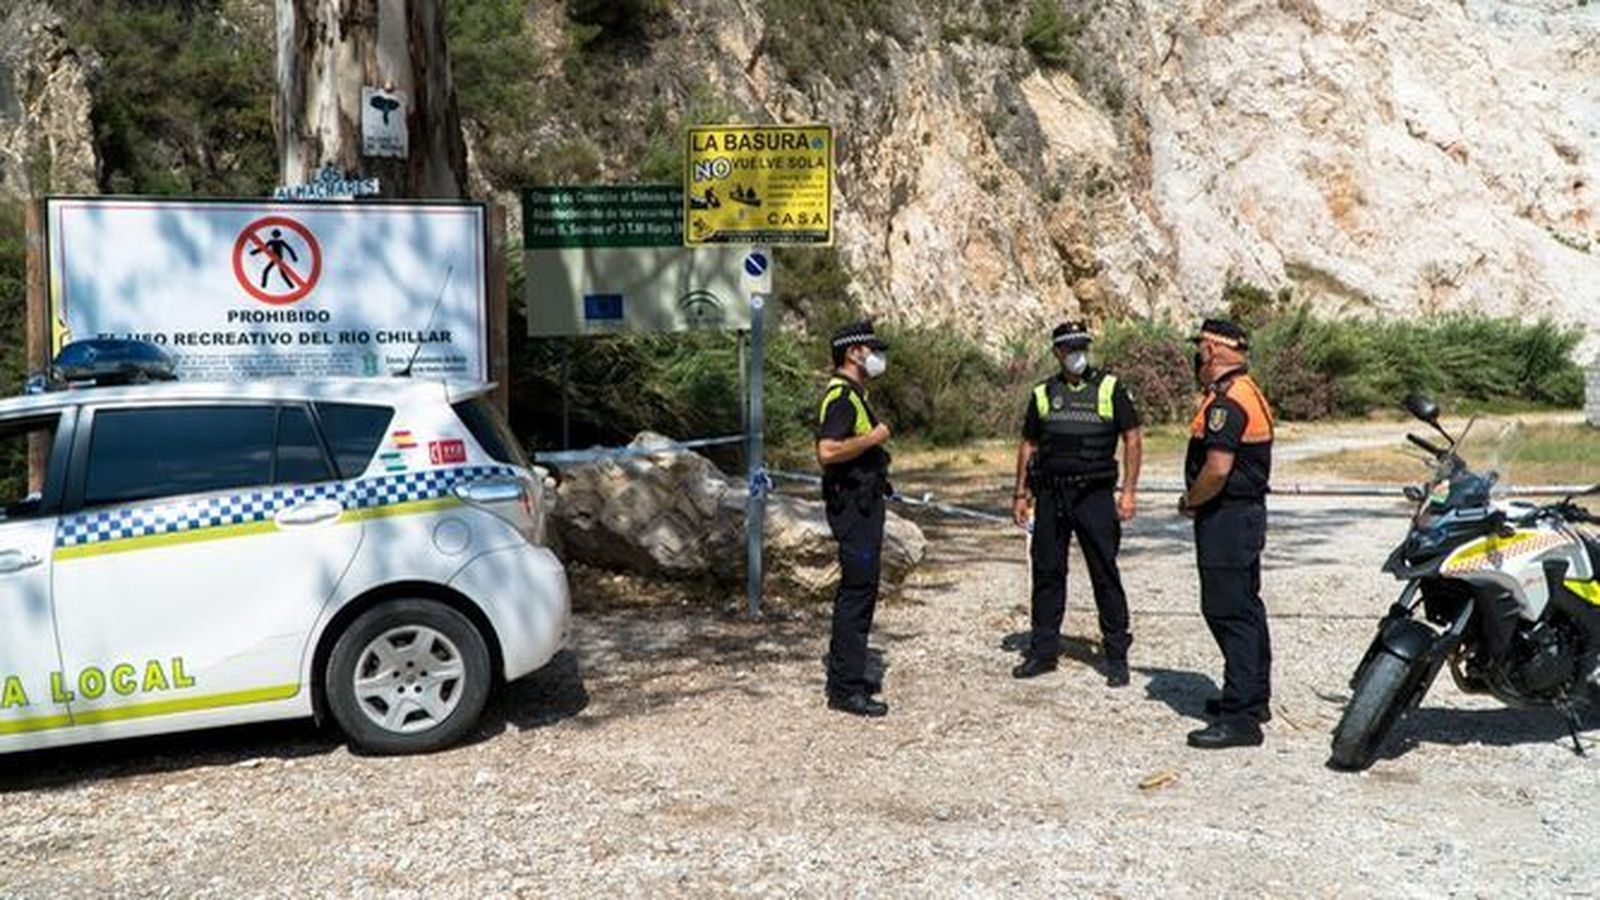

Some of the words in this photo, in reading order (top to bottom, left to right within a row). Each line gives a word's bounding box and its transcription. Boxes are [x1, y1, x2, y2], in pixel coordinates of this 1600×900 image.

[692, 133, 718, 151] LA
[723, 132, 810, 151] BASURA
[694, 157, 731, 181] NO
[732, 157, 783, 169] VUELVE
[787, 156, 825, 169] SOLA
[767, 212, 823, 225] CASA
[227, 310, 330, 323] PROHIBIDO
[173, 332, 292, 346] RECREATIVO
[299, 331, 333, 345] DEL
[376, 330, 452, 344] CHILLAR
[50, 656, 196, 703] LOCAL
